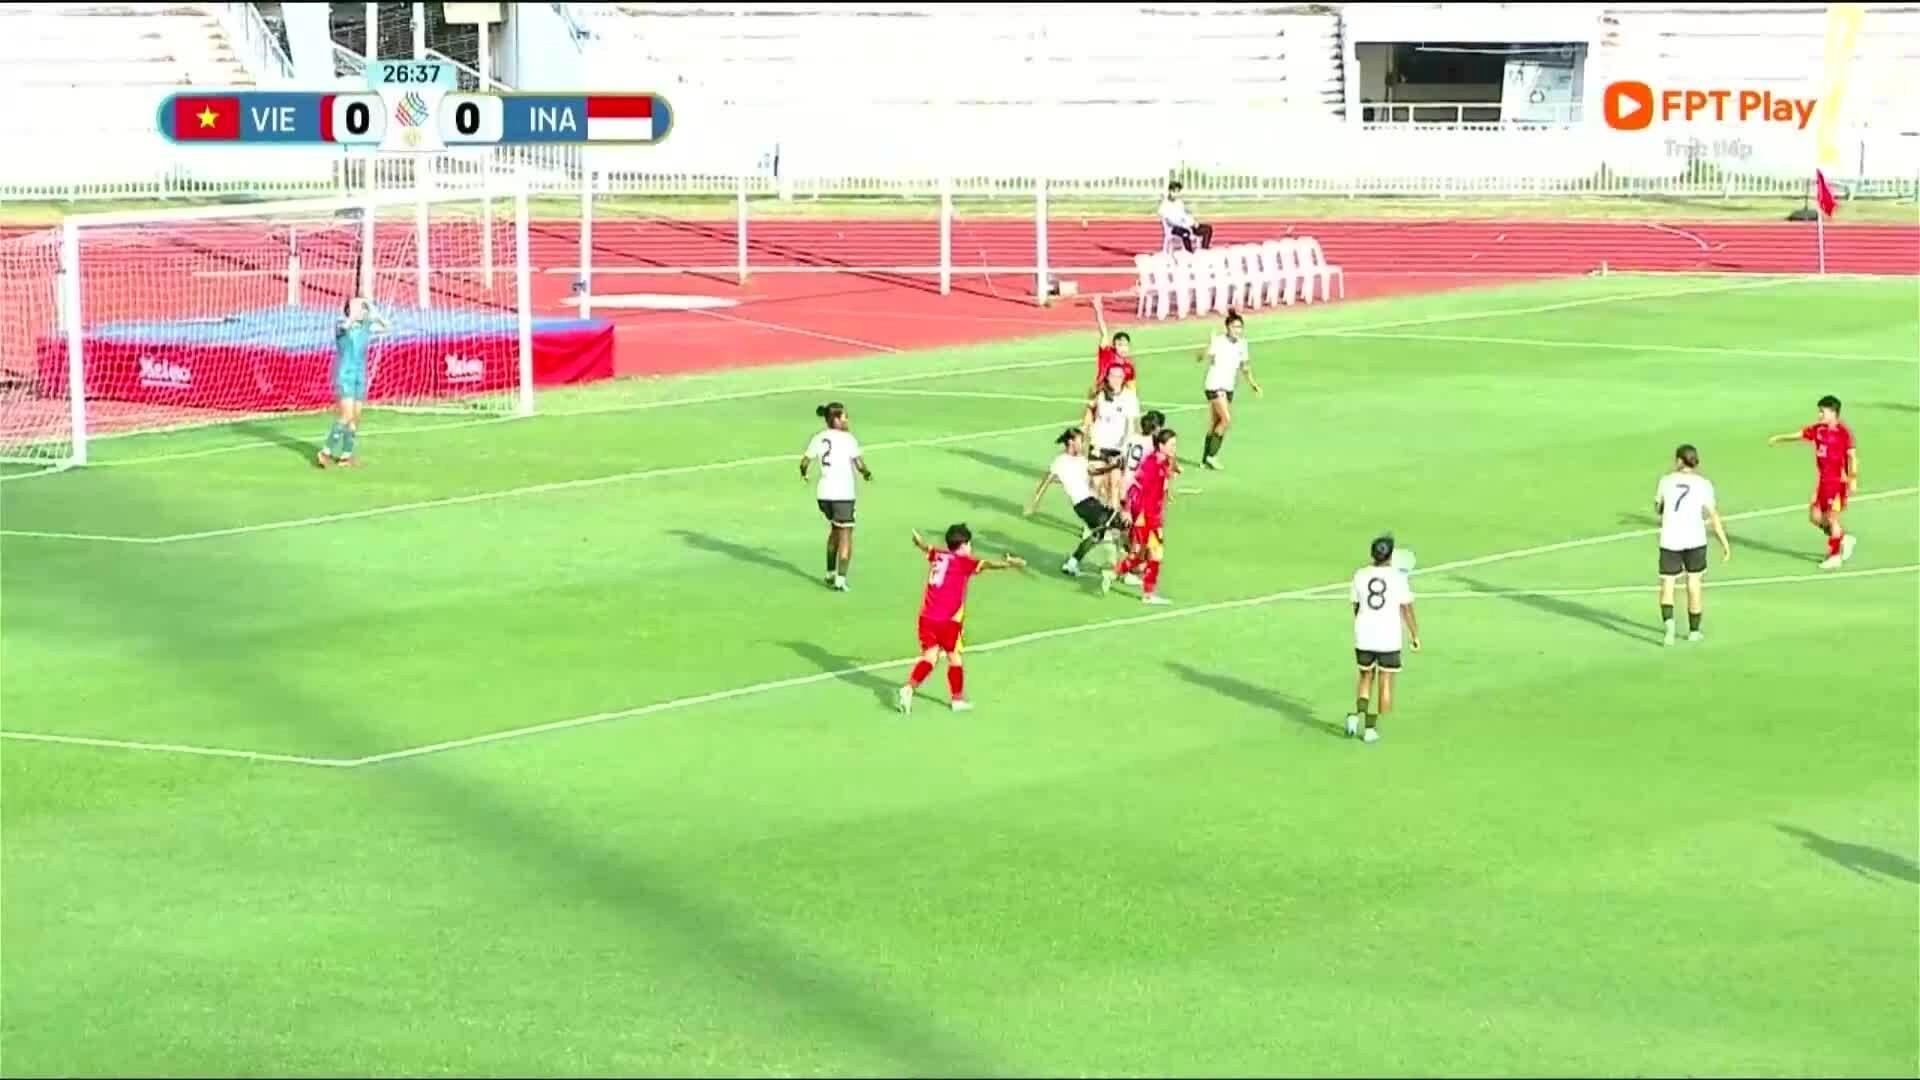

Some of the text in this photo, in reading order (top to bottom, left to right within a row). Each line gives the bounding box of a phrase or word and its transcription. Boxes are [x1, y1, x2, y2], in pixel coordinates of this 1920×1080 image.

[821, 438, 832, 467] 2
[1126, 443, 1143, 471] 19
[1674, 483, 1691, 512] 7
[1367, 577, 1387, 611] 8
